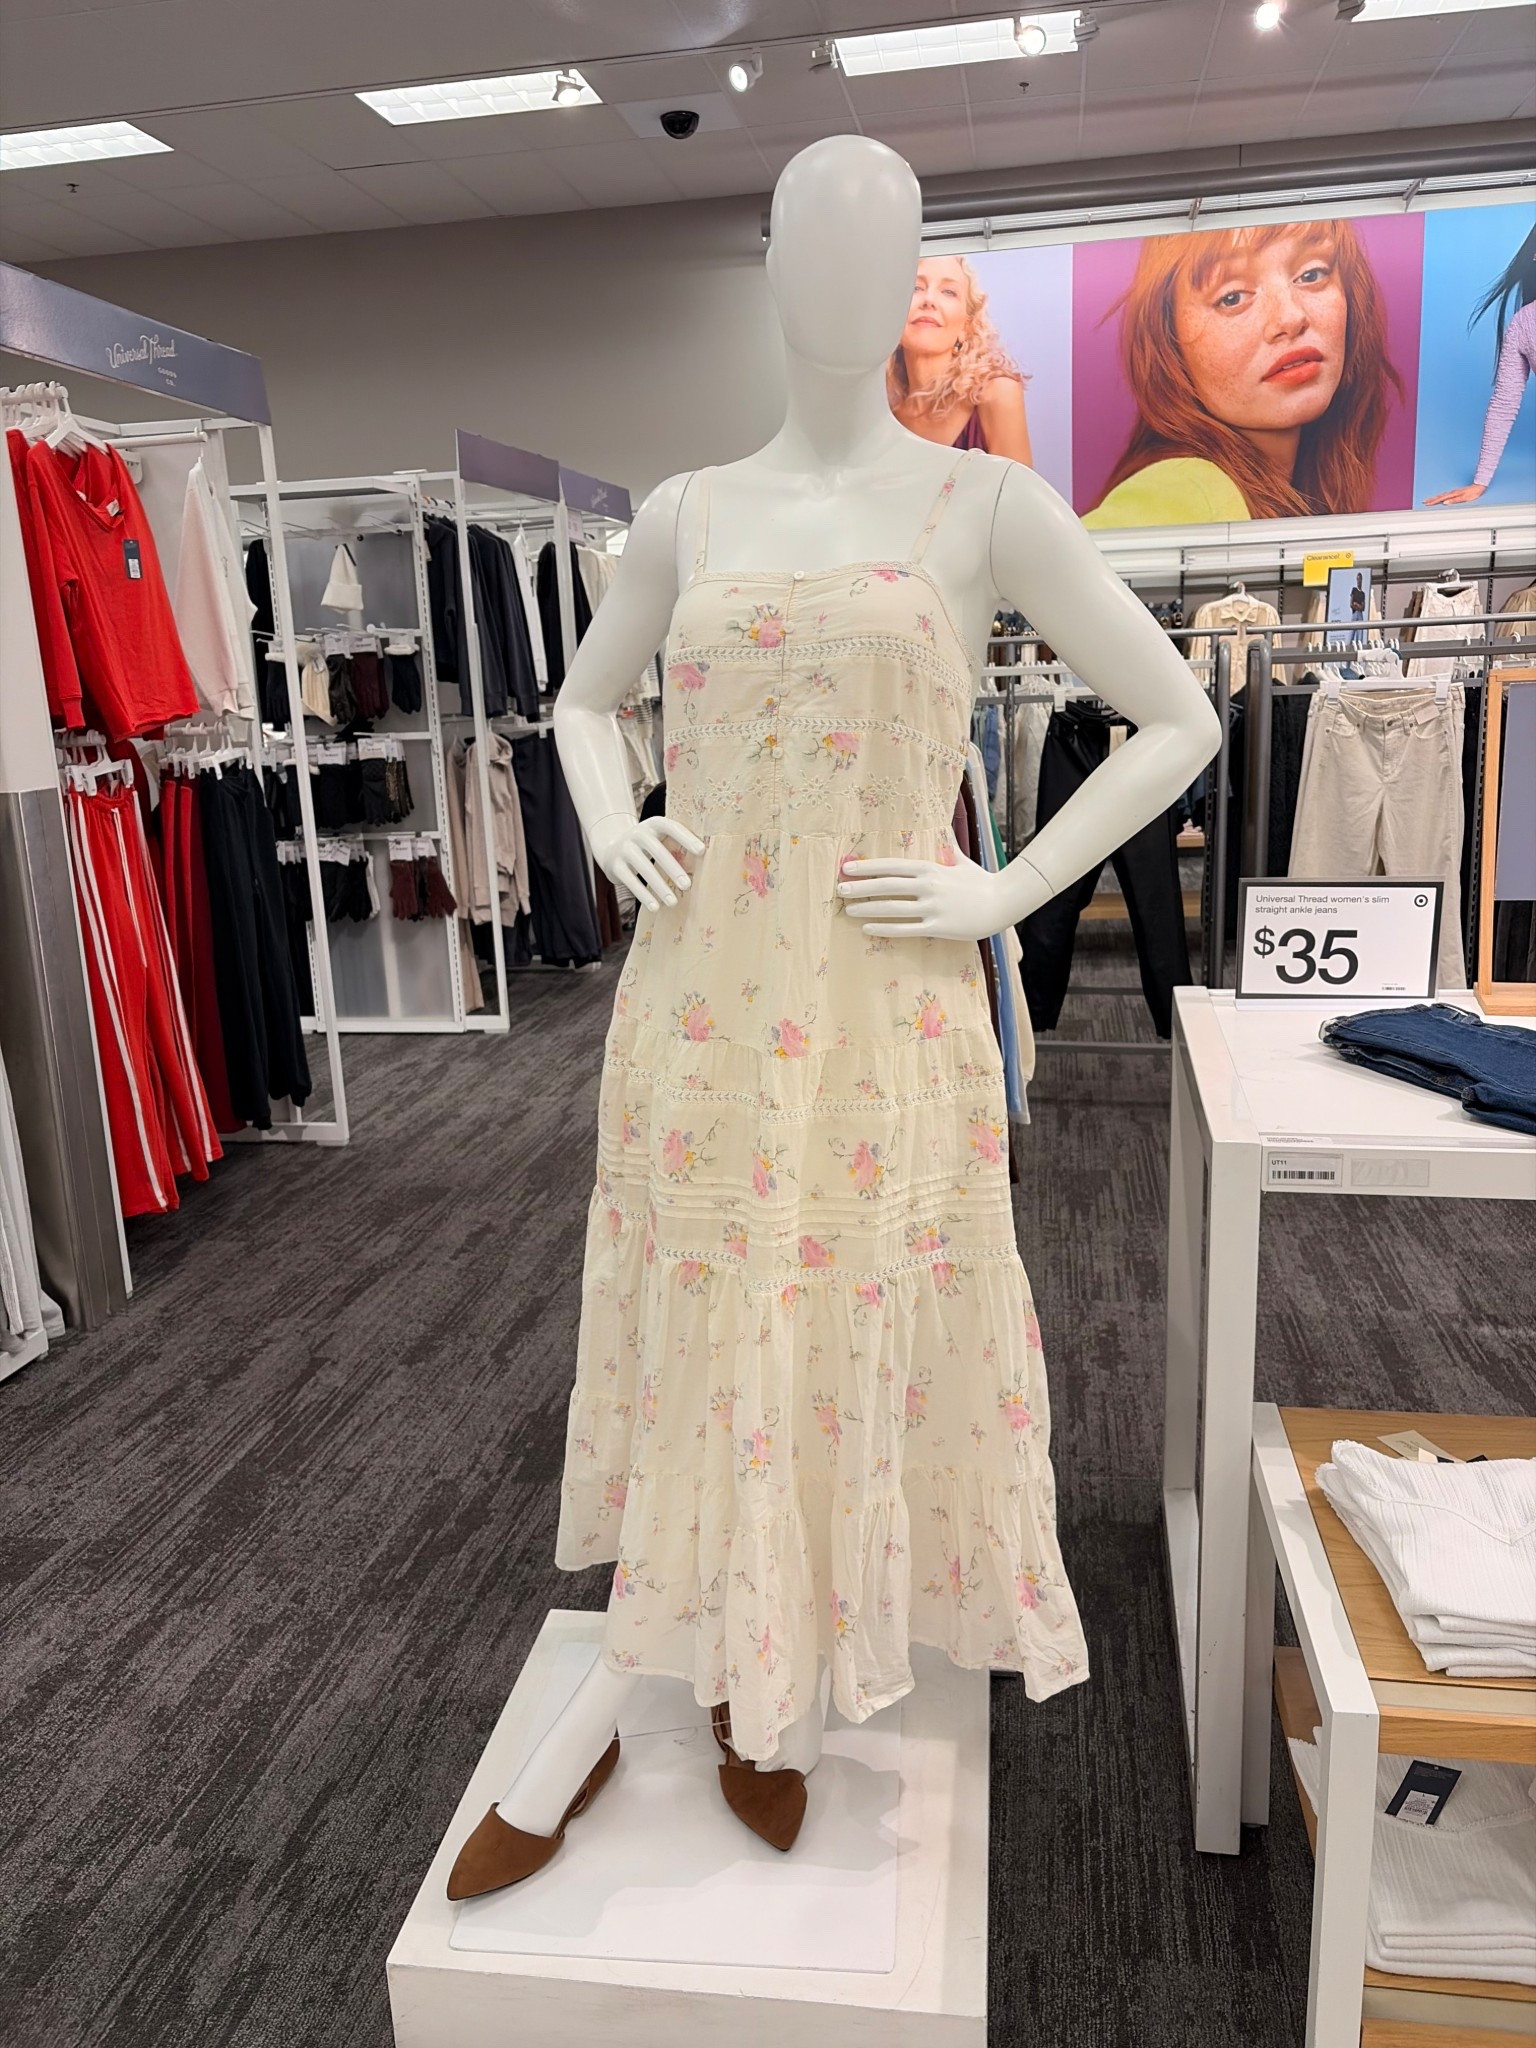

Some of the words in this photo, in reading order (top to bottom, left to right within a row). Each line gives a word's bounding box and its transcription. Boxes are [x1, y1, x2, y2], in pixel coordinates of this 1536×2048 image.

[105, 343, 149, 368] Universal
[140, 334, 178, 364] Thread
[1256, 895, 1296, 903] Universal
[1298, 895, 1328, 903] Thread
[1372, 896, 1390, 904] slim
[1255, 906, 1288, 915] straight
[1289, 906, 1313, 914] ankle
[1314, 907, 1338, 915] jeans
[1253, 925, 1359, 985] $35
